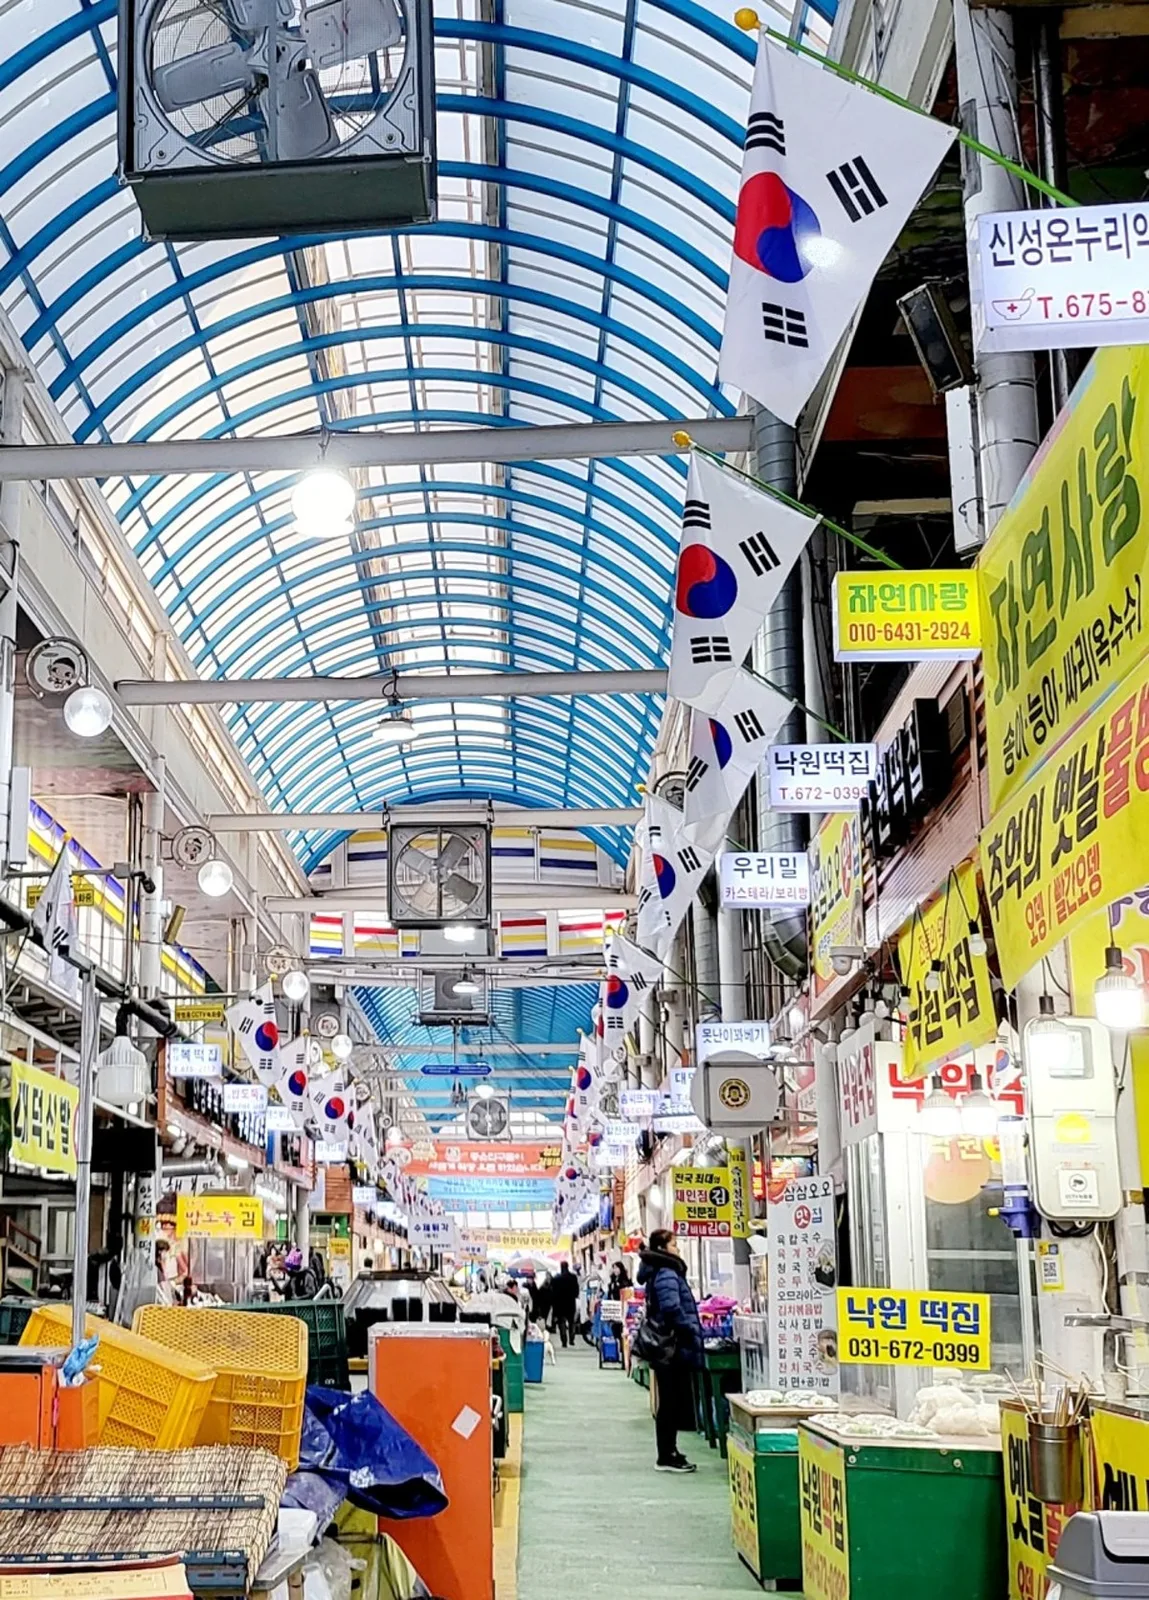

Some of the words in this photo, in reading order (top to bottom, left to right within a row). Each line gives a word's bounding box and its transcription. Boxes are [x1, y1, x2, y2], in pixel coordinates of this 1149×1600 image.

[989, 374, 1141, 706] 자연사랑
[847, 582, 969, 615] 자연사랑
[848, 621, 972, 644] 010-6431-2924
[774, 750, 870, 777] 낙원떡집
[987, 785, 1046, 922] 추억의
[1051, 724, 1106, 868] 옛날
[733, 856, 798, 879] 우리밀
[702, 1027, 765, 1044] 못난이꽈배기
[674, 1173, 694, 1184] 전국
[711, 1188, 728, 1206] 김
[784, 1180, 832, 1201] 삼삼오오
[240, 1211, 255, 1227] 김
[777, 1290, 823, 1301] 오므라이스
[847, 1297, 907, 1331] 낙원
[920, 1299, 980, 1335] 떡집
[849, 1337, 980, 1364] 031-672-0399
[801, 1456, 845, 1554] 낙원떡집
